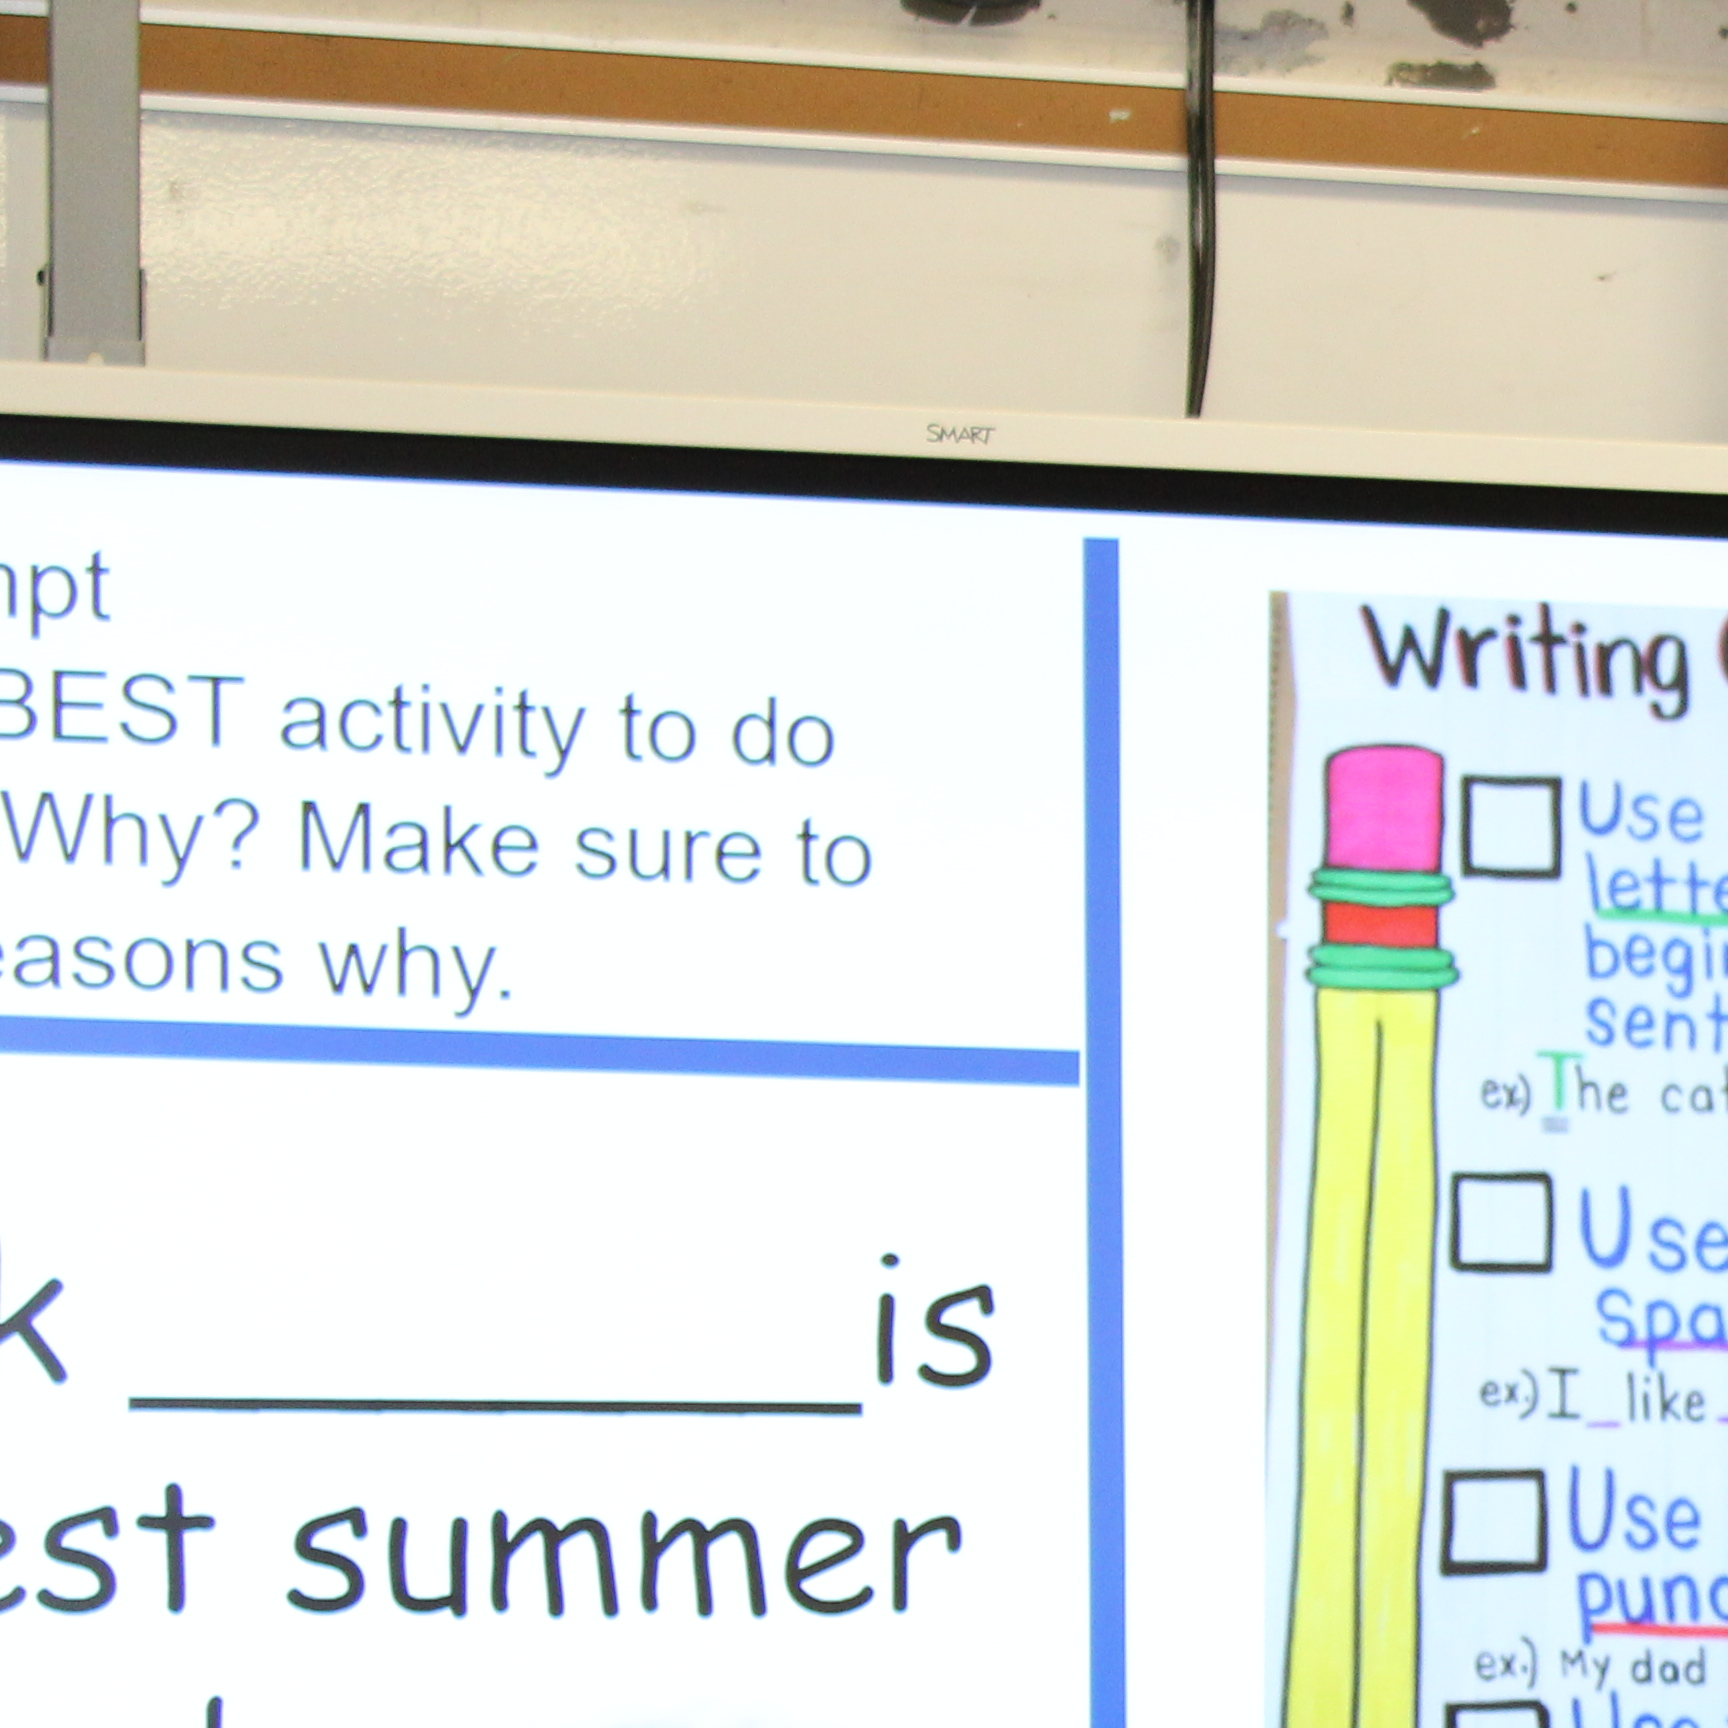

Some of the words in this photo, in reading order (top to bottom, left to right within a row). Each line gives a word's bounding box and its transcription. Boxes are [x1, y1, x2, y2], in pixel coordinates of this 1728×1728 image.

[927, 422, 996, 446] SMART
[1359, 600, 1690, 723] Writing
[280, 686, 586, 777] activity
[620, 691, 697, 764] to
[732, 698, 836, 768] do
[0, 791, 261, 885] Why?
[301, 801, 540, 878] Make
[575, 823, 762, 883] sure
[798, 818, 874, 886] to
[1579, 778, 1705, 844] Use
[0, 933, 284, 992] asons
[321, 929, 513, 1016] why.
[1535, 1050, 1629, 1114] The
[877, 1251, 995, 1387] is
[1548, 1367, 1581, 1422] I
[1626, 1370, 1705, 1424] like
[1570, 1464, 1702, 1553] Use
[286, 1505, 961, 1619] summer
[1561, 1650, 1611, 1690] My
[1631, 1648, 1705, 1687] dad
